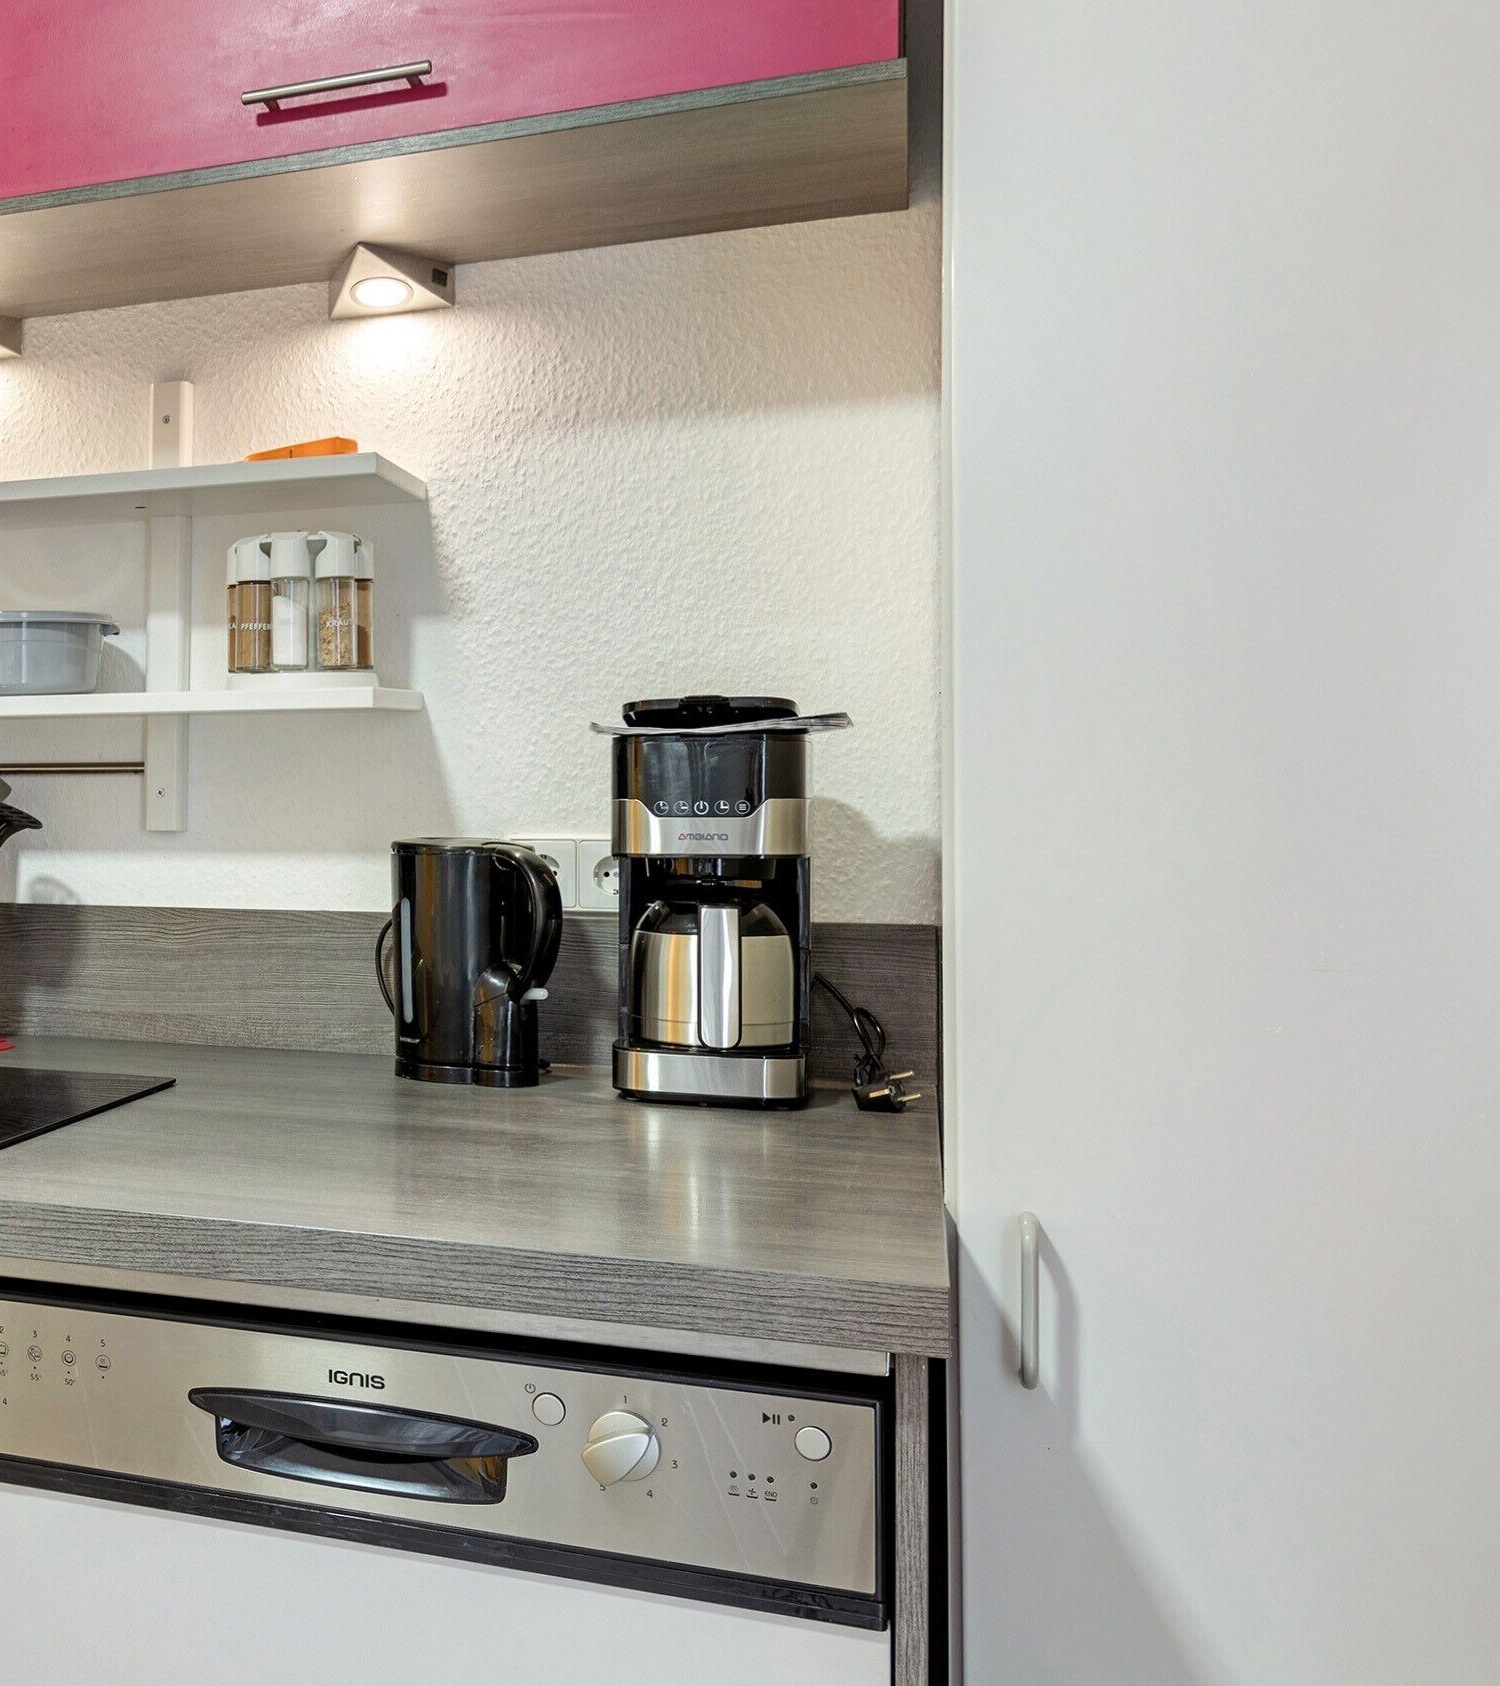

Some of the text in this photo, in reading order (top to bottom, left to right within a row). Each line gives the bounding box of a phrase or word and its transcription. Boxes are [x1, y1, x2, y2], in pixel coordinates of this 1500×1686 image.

[678, 833, 729, 841] AMBIANO
[32, 1329, 39, 1339] 3
[65, 1334, 72, 1343] 4
[328, 1368, 386, 1390] IGNIS
[2, 1397, 8, 1406] 4
[623, 1395, 628, 1404] 1
[661, 1417, 668, 1427] 2
[671, 1459, 679, 1469] 3
[646, 1489, 654, 1498] 4
